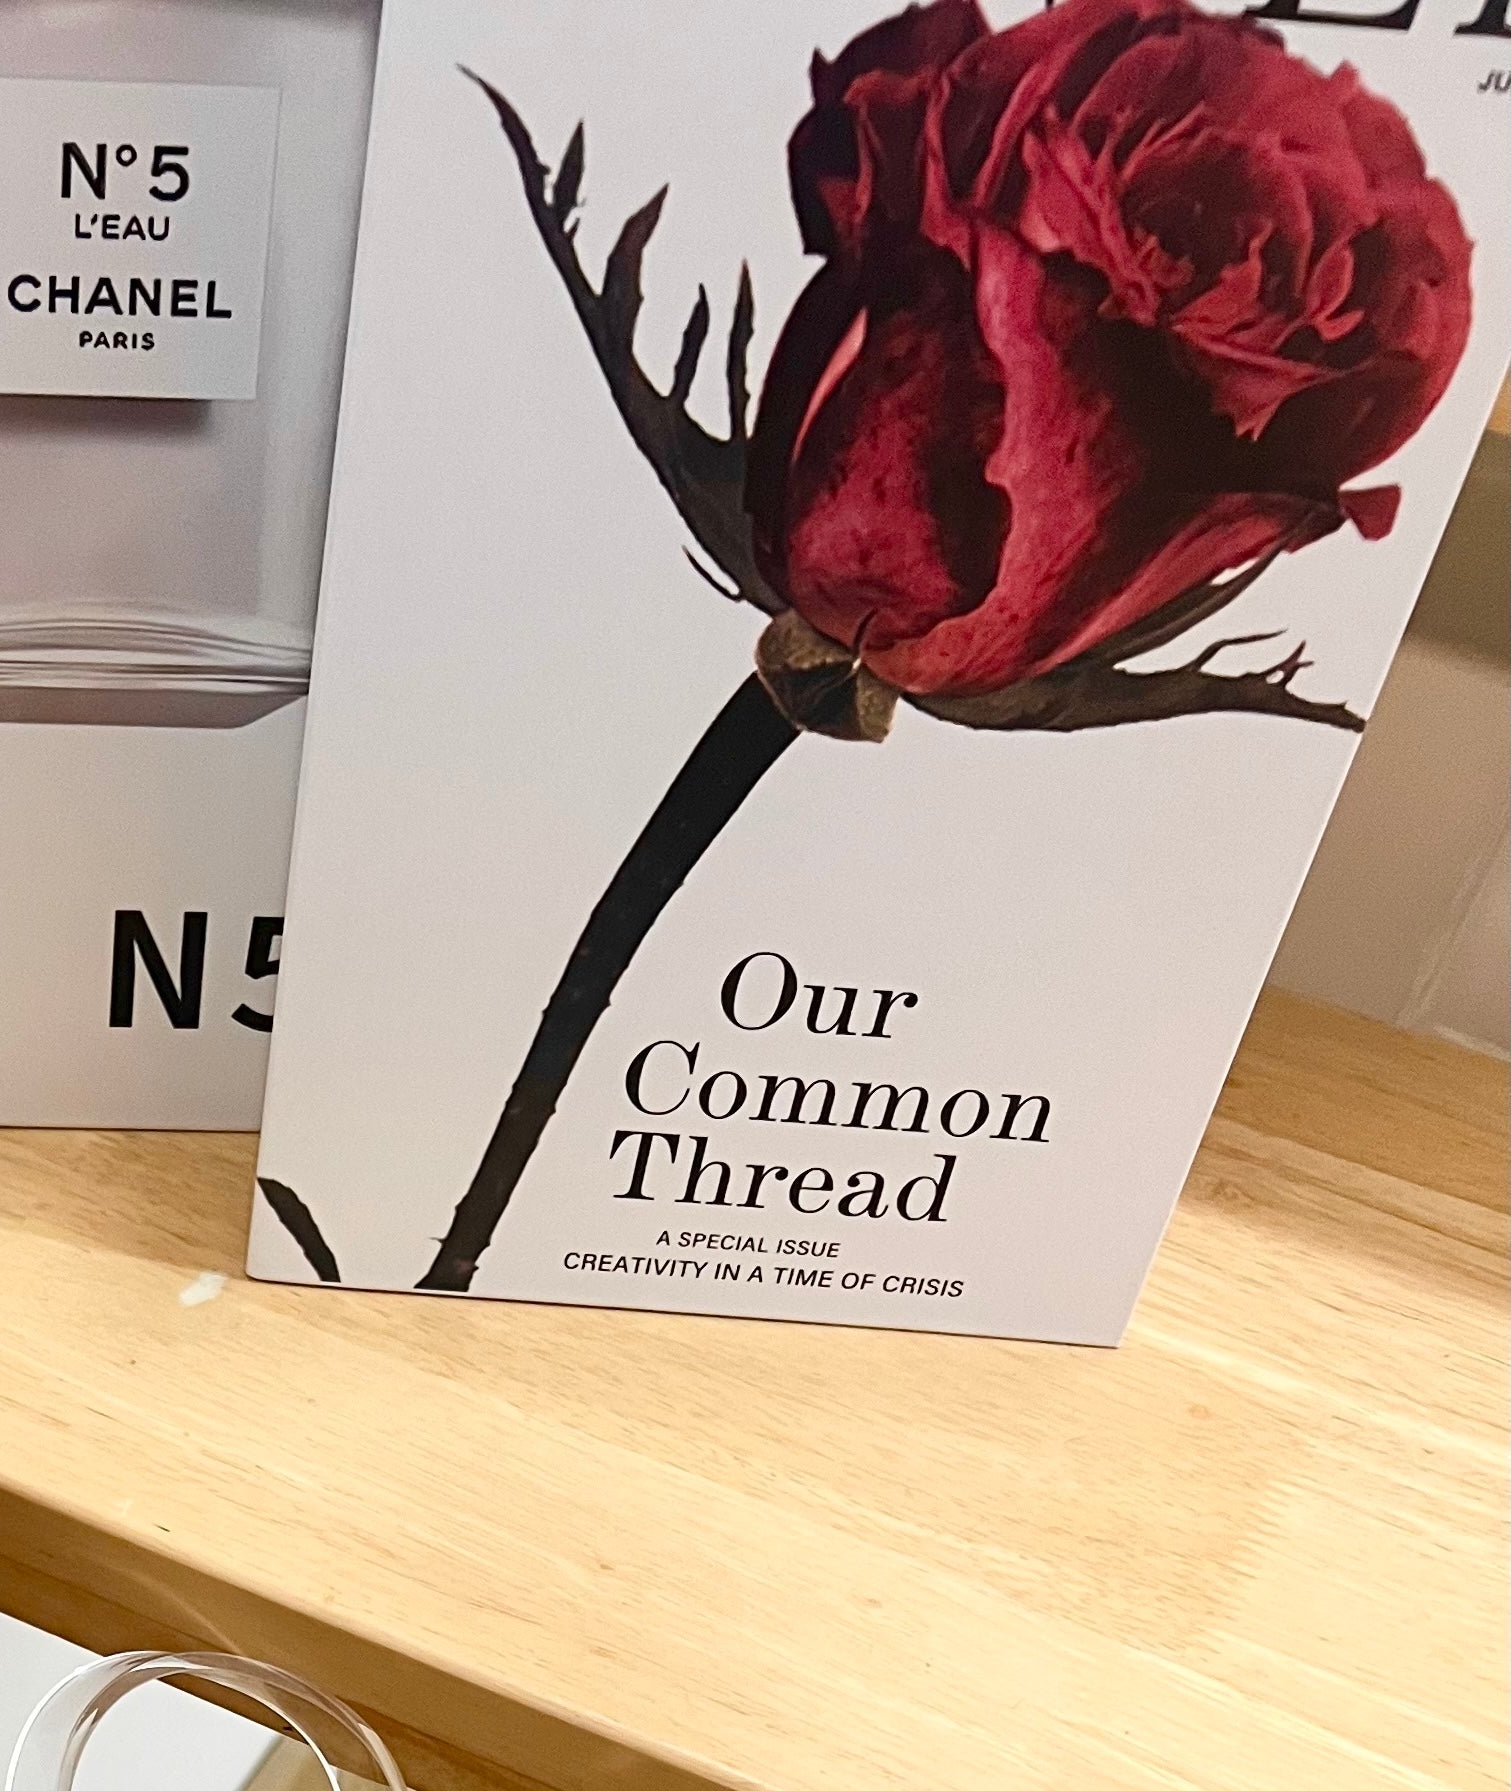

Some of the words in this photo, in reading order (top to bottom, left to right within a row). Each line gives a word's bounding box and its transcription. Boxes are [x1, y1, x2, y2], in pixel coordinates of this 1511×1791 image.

[61, 142, 190, 201] N°5
[75, 213, 170, 241] L'EAU
[7, 274, 232, 319] CHANEL
[79, 331, 155, 351] PARIS
[720, 951, 919, 1039] Our
[624, 1040, 1052, 1143] Common
[608, 1129, 957, 1222] Thread
[656, 1230, 671, 1246] A
[678, 1231, 768, 1254] SPECIAL
[776, 1238, 841, 1258] ISSUE
[563, 1252, 708, 1279] CREATIVITY
[714, 1262, 741, 1281] IN
[746, 1265, 764, 1283] A
[774, 1266, 835, 1288] TIME
[841, 1272, 877, 1290] OF
[882, 1275, 965, 1298] CRISIS
